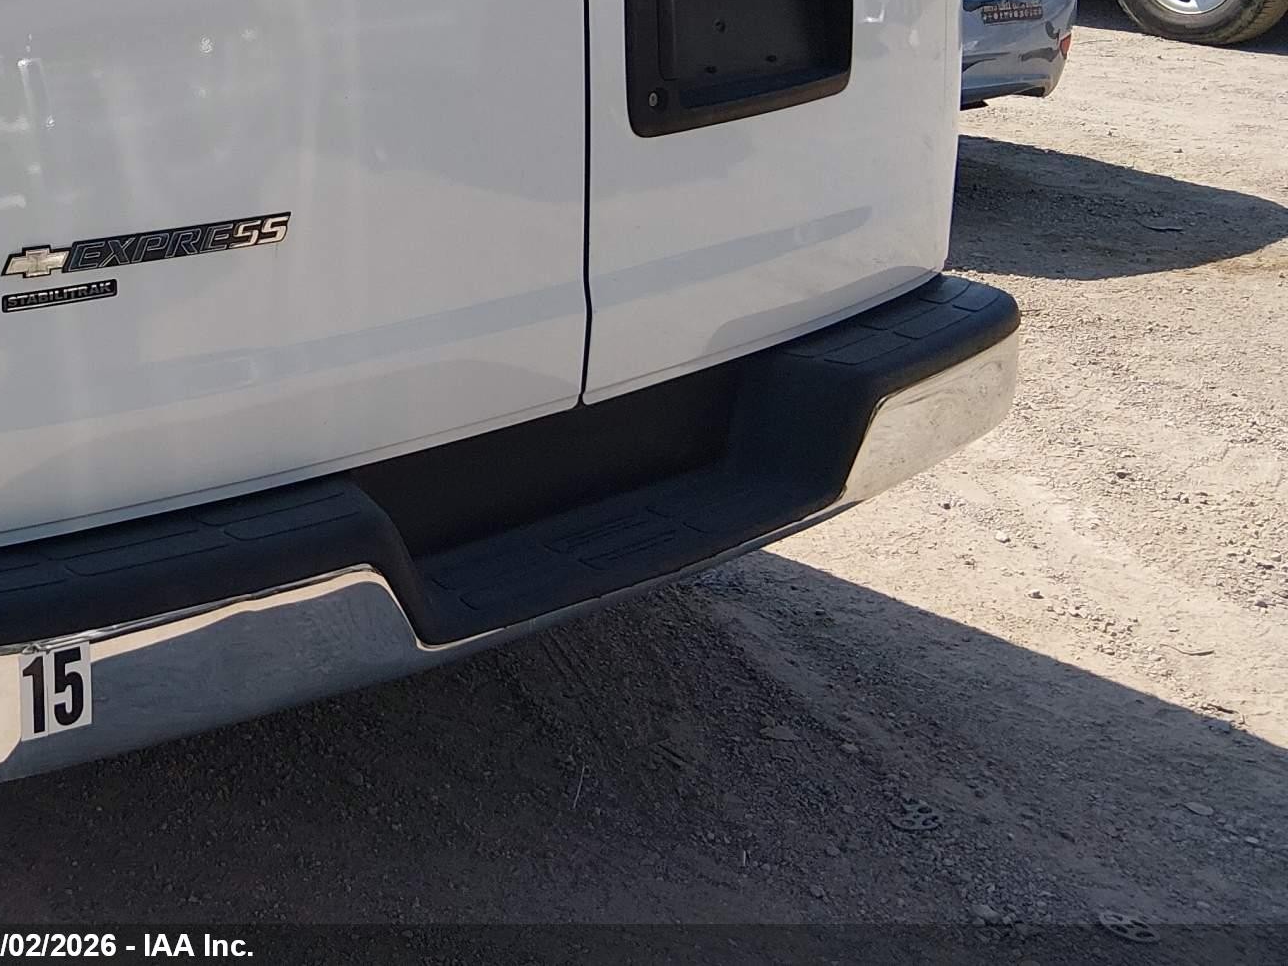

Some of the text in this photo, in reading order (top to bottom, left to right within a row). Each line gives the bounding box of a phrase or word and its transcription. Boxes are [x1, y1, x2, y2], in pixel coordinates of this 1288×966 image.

[68, 215, 290, 273] EXPRESS
[7, 281, 112, 308] STABILITRAK
[22, 646, 85, 735] 15
